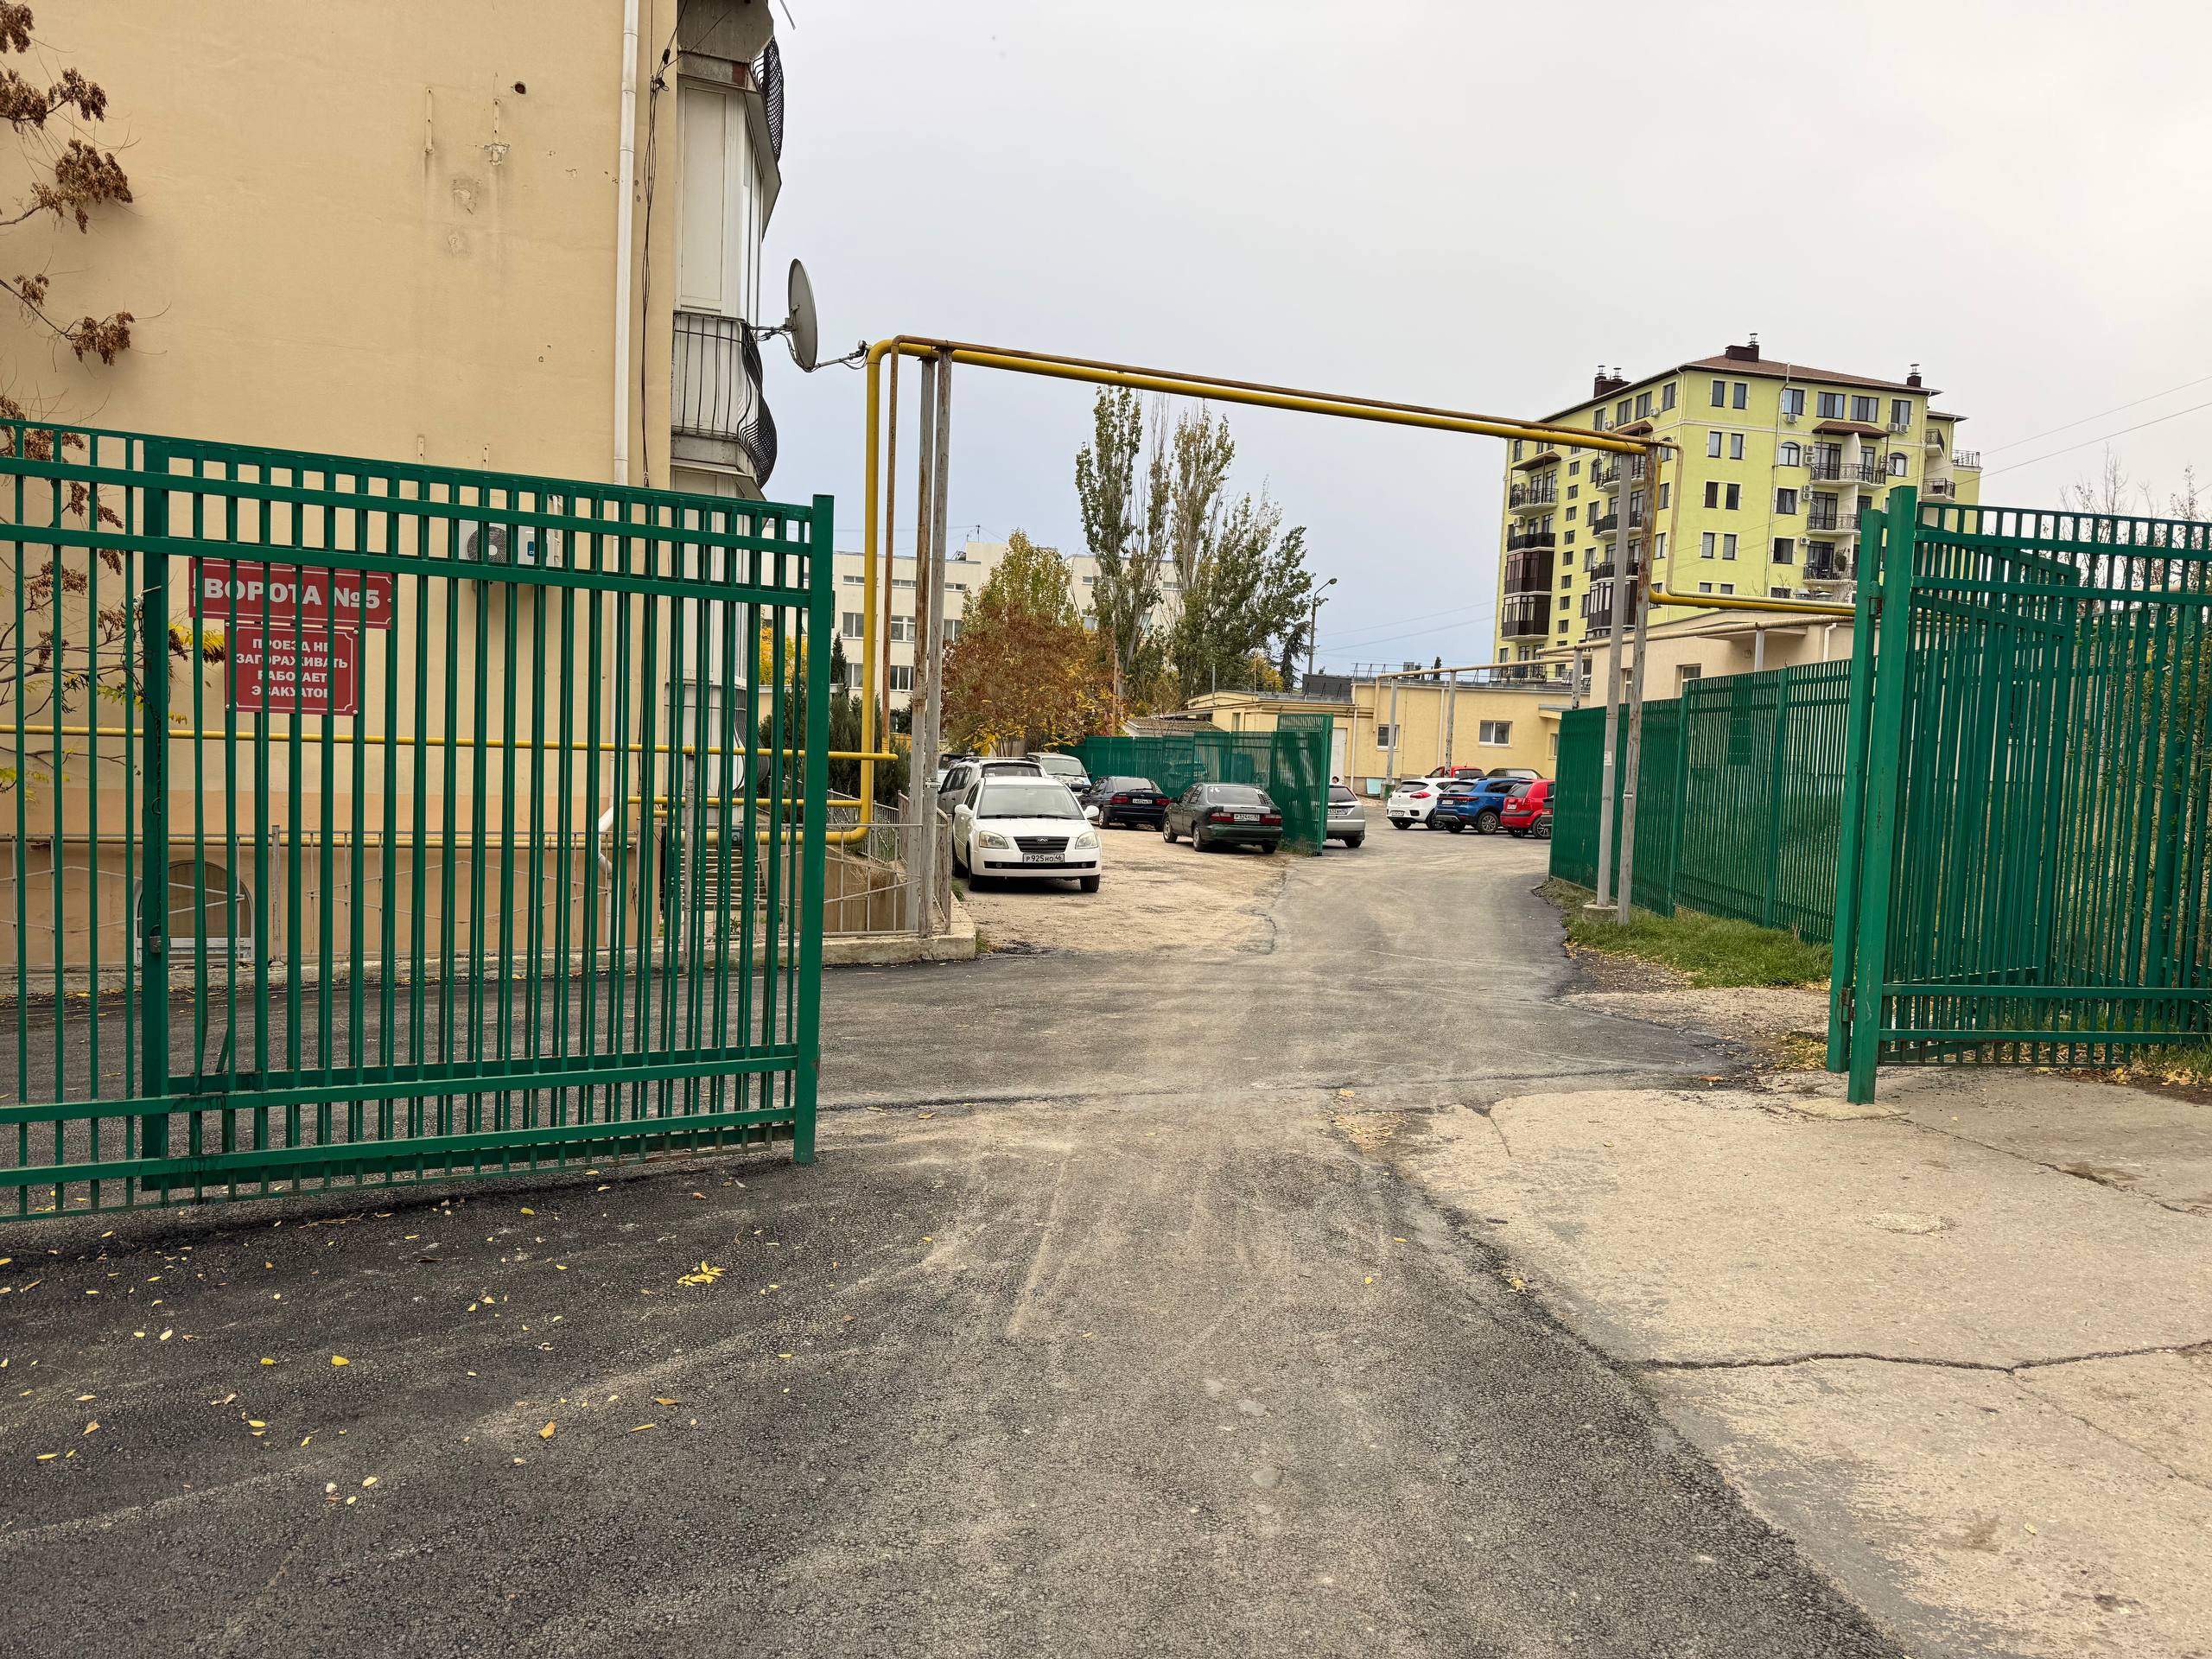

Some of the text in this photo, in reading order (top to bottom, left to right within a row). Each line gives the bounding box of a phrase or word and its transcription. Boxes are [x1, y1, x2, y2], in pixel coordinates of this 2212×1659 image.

[204, 577, 322, 606] ВОРОТА
[252, 639, 311, 652] ПОЕЗД
[257, 670, 327, 683] РАБОАЕТ
[251, 685, 328, 698] ЭАКУТО
